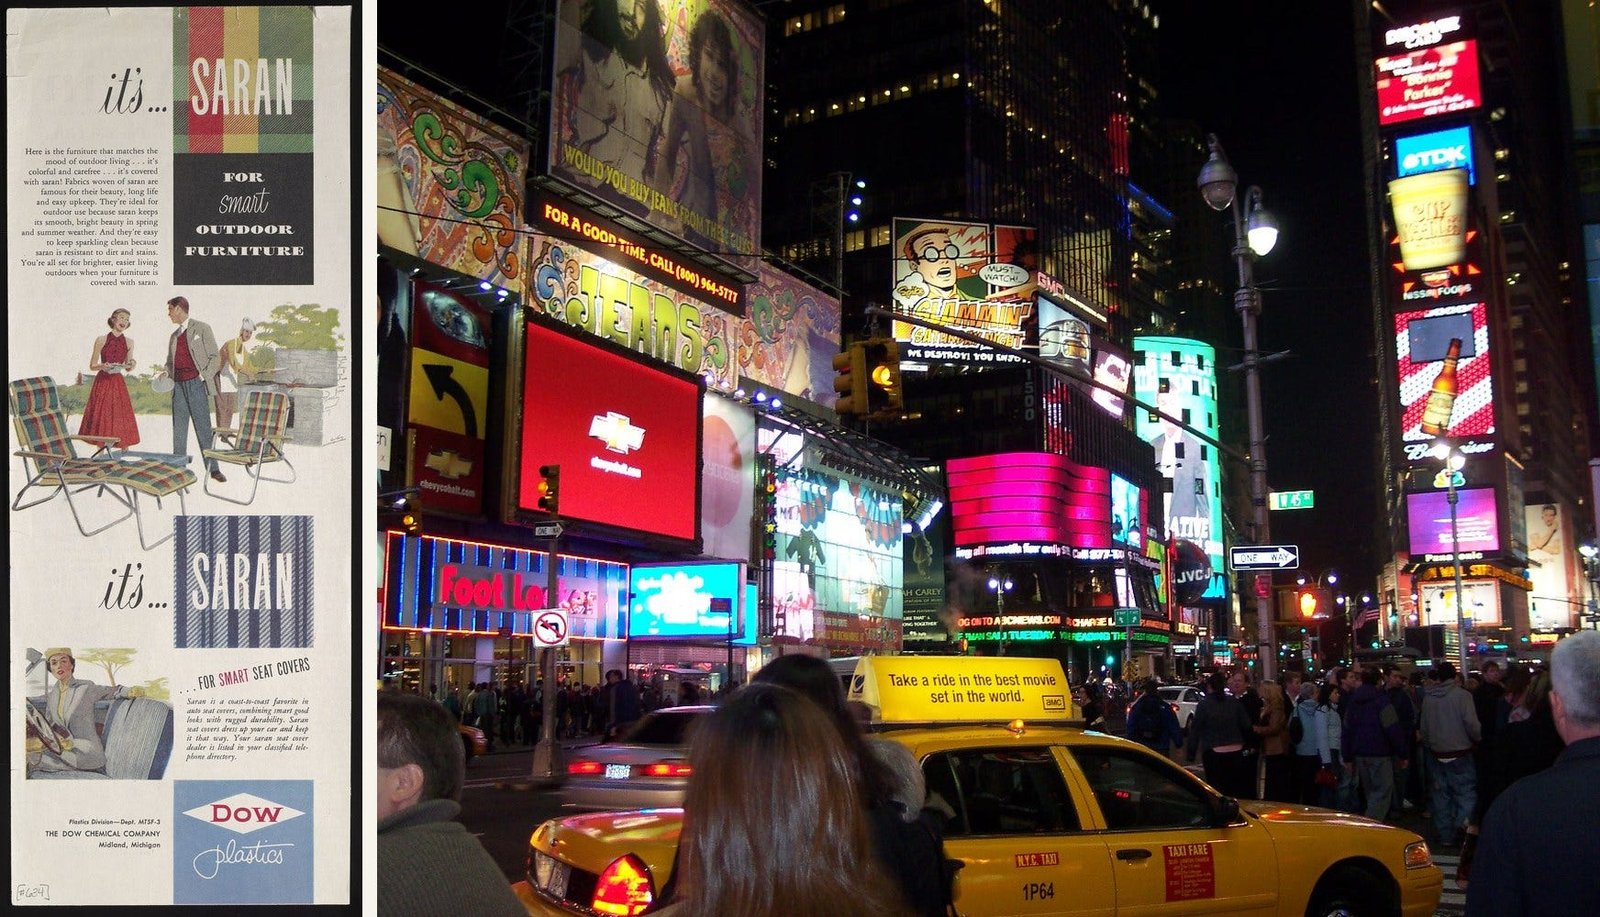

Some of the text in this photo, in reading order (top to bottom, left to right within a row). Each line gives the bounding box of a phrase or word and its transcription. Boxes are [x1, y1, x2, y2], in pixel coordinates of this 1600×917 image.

[191, 57, 293, 116] SARAN
[110, 158, 130, 166] living
[1418, 145, 1467, 166] TDK
[222, 172, 265, 183] FOR
[564, 144, 604, 181] WOULD
[605, 166, 628, 193] YOU
[629, 179, 650, 202] BUY
[651, 189, 679, 218] JEANS
[129, 188, 144, 196] long
[218, 187, 270, 214] smart
[139, 209, 158, 217] keeps
[195, 224, 294, 235] OUTDOOR
[184, 246, 305, 257] FURNITURE
[545, 204, 738, 304] FOR A GOOD TIME, CALL (800) 964-5777
[566, 265, 700, 374] JEANS
[973, 353, 994, 361] YOU
[420, 480, 476, 497] chevycobalt.com
[537, 527, 548, 535] ONE
[1240, 553, 1290, 563] ONE WAY
[1425, 551, 1483, 562] Panaonic
[191, 552, 293, 610] SARAN
[1177, 569, 1203, 584] JVC
[441, 564, 504, 607] Foot
[915, 588, 943, 597] CAREY
[198, 657, 311, 690] FOR SMART SEAT COVERS
[888, 673, 1056, 687] Take a ride in the best movie
[931, 690, 1025, 704] set in the world.
[1168, 844, 1209, 857] TAXI FARE
[193, 839, 294, 879] plastics
[1017, 853, 1057, 867] N.Y.C. TAXI
[1023, 882, 1054, 900] 1P64
